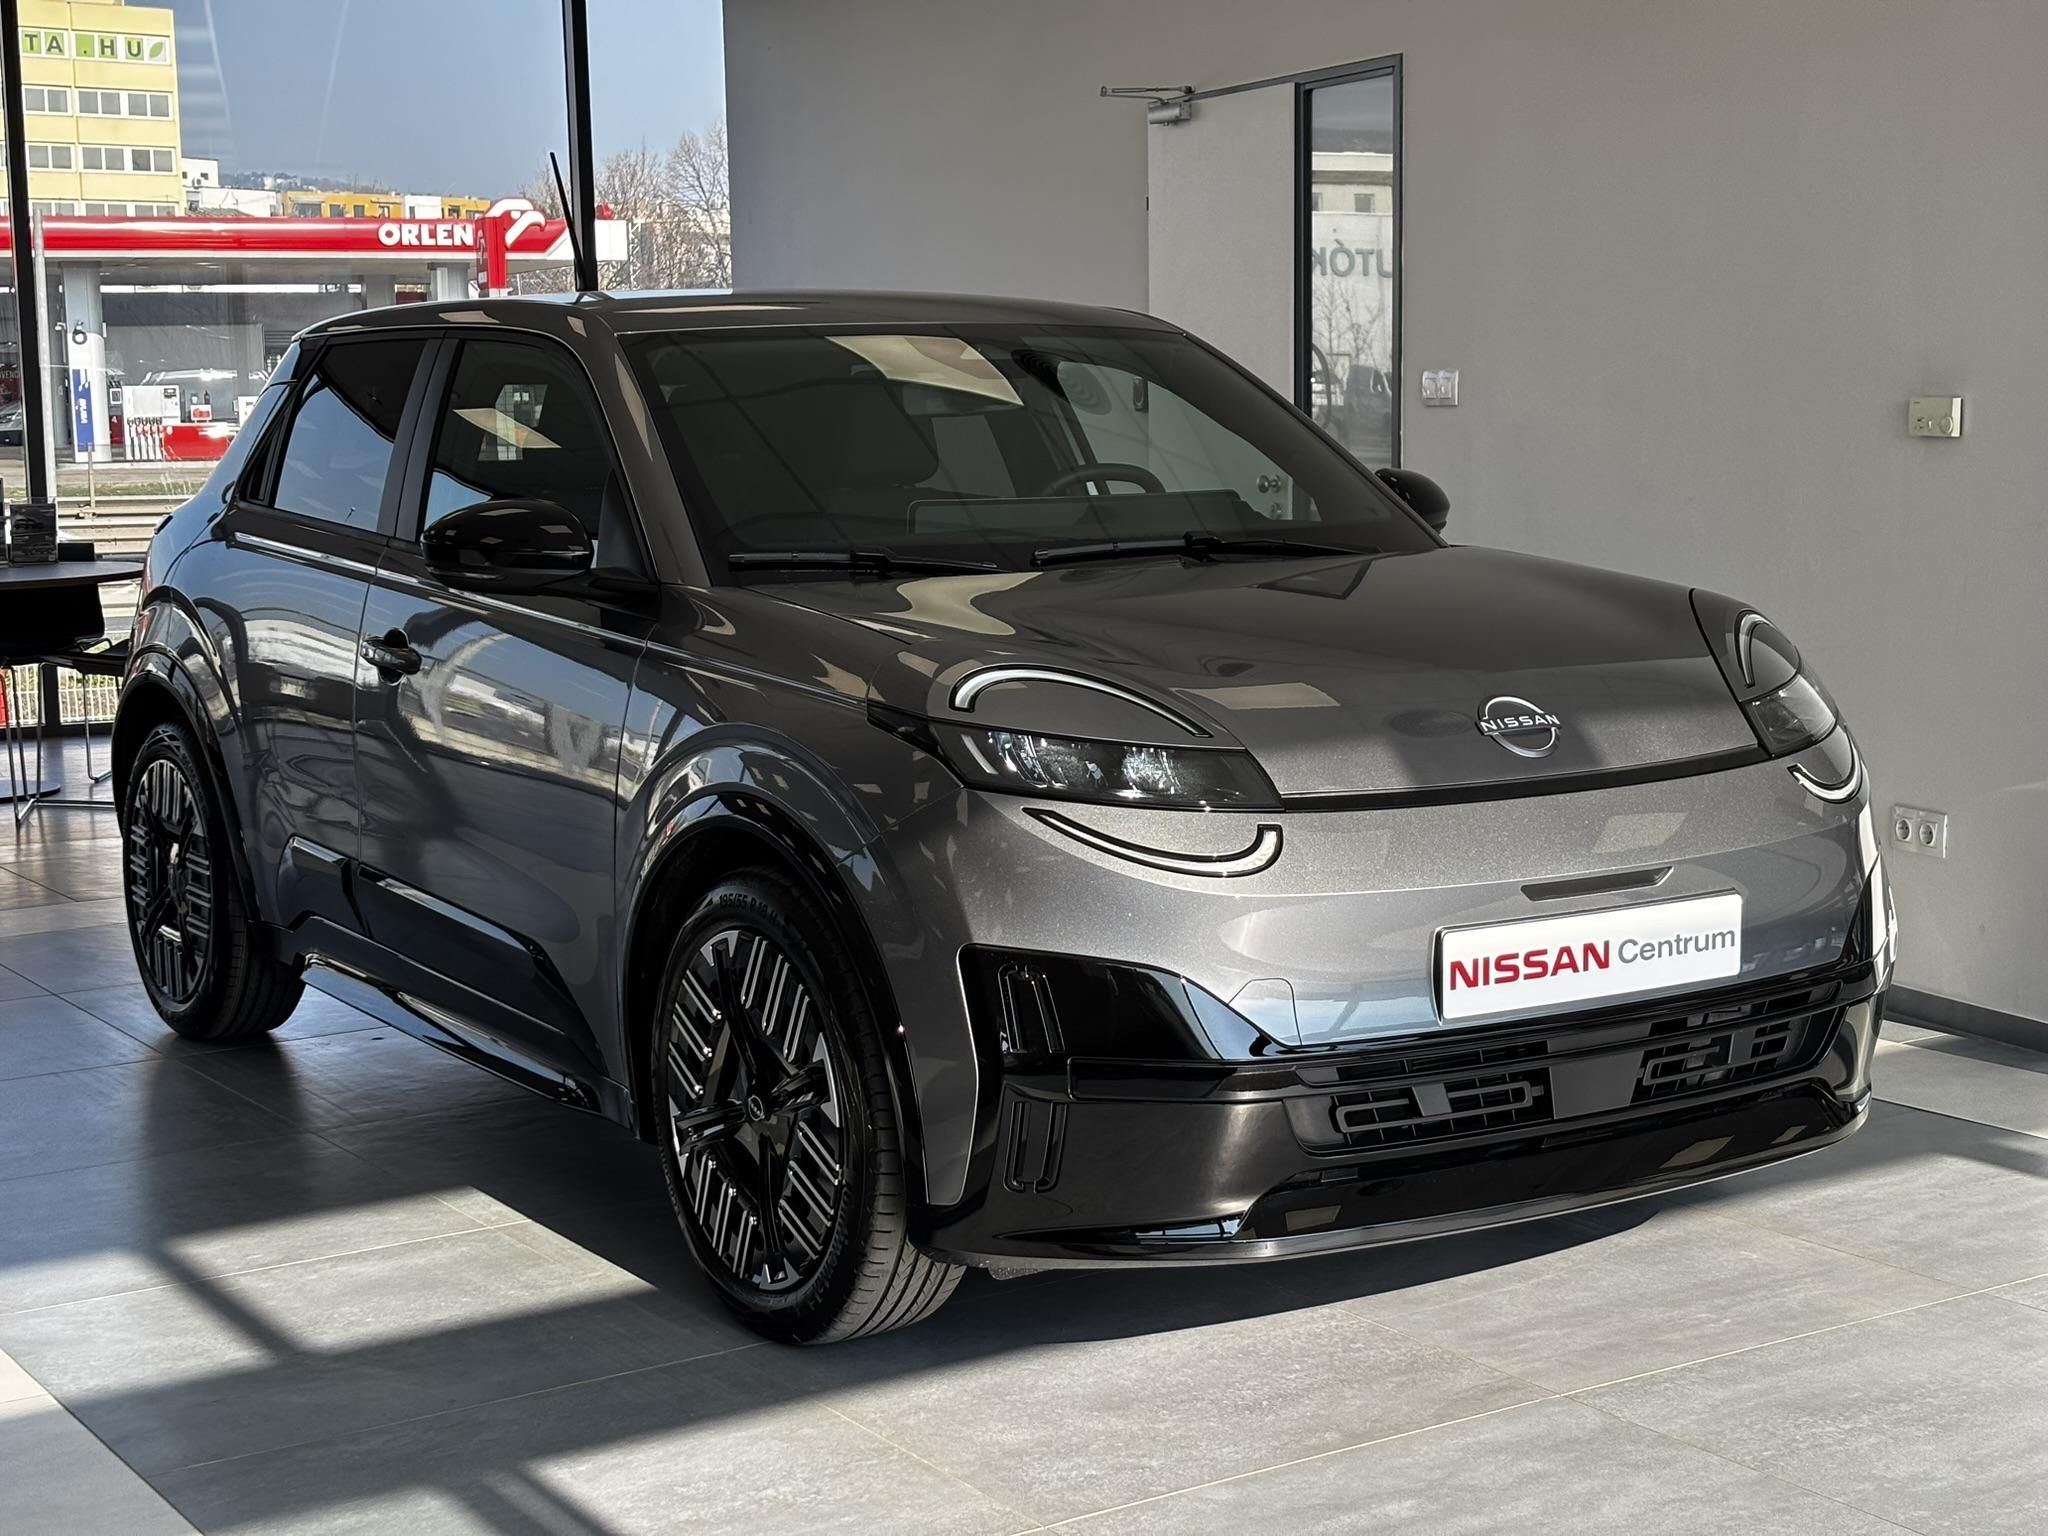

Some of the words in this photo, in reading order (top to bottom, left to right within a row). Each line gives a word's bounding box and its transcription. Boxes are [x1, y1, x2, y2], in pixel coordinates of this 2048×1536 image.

[378, 222, 474, 247] ORLEN
[1480, 714, 1561, 732] NISSAN
[1449, 939, 1610, 991] NISSAN
[1617, 929, 1736, 965] Centrum
